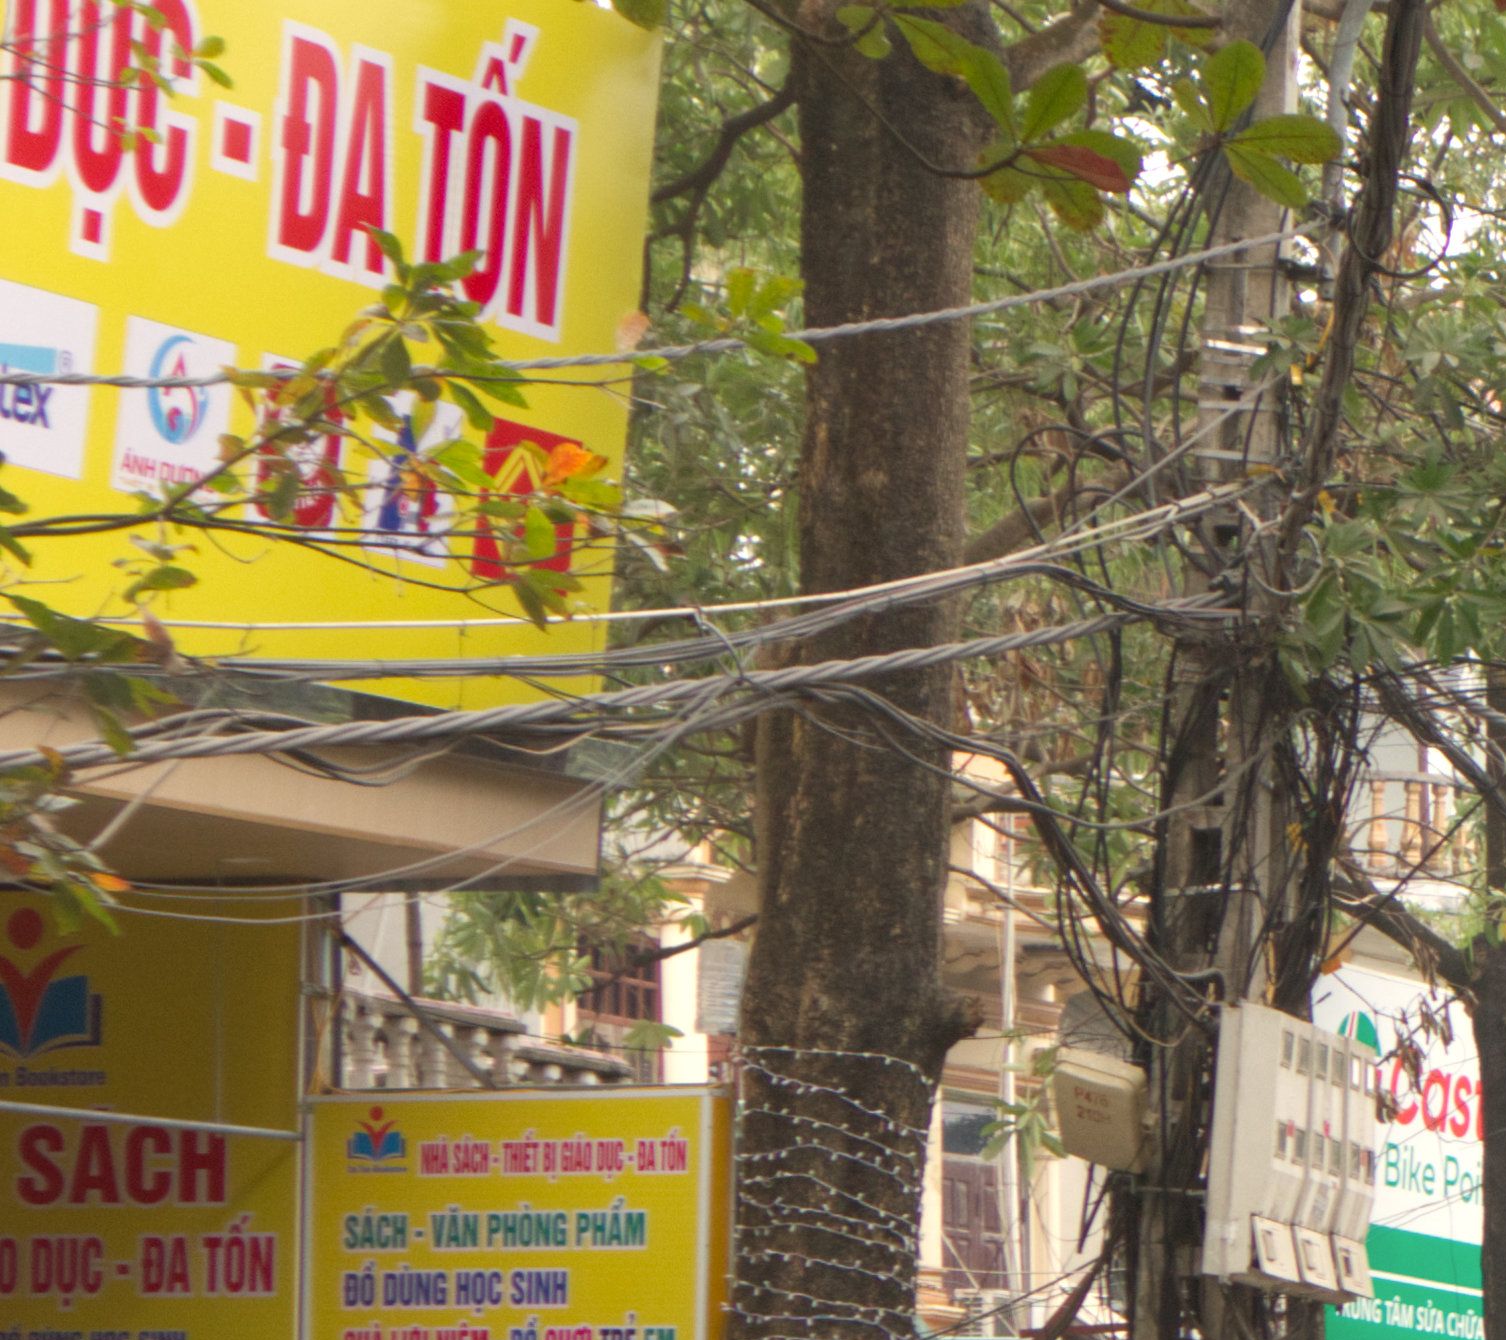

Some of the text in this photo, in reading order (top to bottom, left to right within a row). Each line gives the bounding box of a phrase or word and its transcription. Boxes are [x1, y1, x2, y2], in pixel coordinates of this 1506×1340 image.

[278, 36, 390, 277] ĐA
[415, 32, 574, 328] TỐN
[420, 1128, 687, 1181] NHÀ SÁCH THIẾT BỊ GIÁO DỤC ĐA TỐN
[1385, 1142, 1437, 1196] Bike
[344, 1198, 646, 1249] SÁCH VĂN PHÒNG PHẨM
[31, 1236, 104, 1308] DỤC
[141, 1236, 191, 1293] ĐA
[203, 1214, 275, 1293] TỐN
[383, 1263, 448, 1305] DÙNG
[455, 1270, 503, 1314] HỌC
[511, 1270, 568, 1305] SINH
[1384, 1297, 1415, 1330] TÂM
[1415, 1299, 1445, 1334] SỬA
